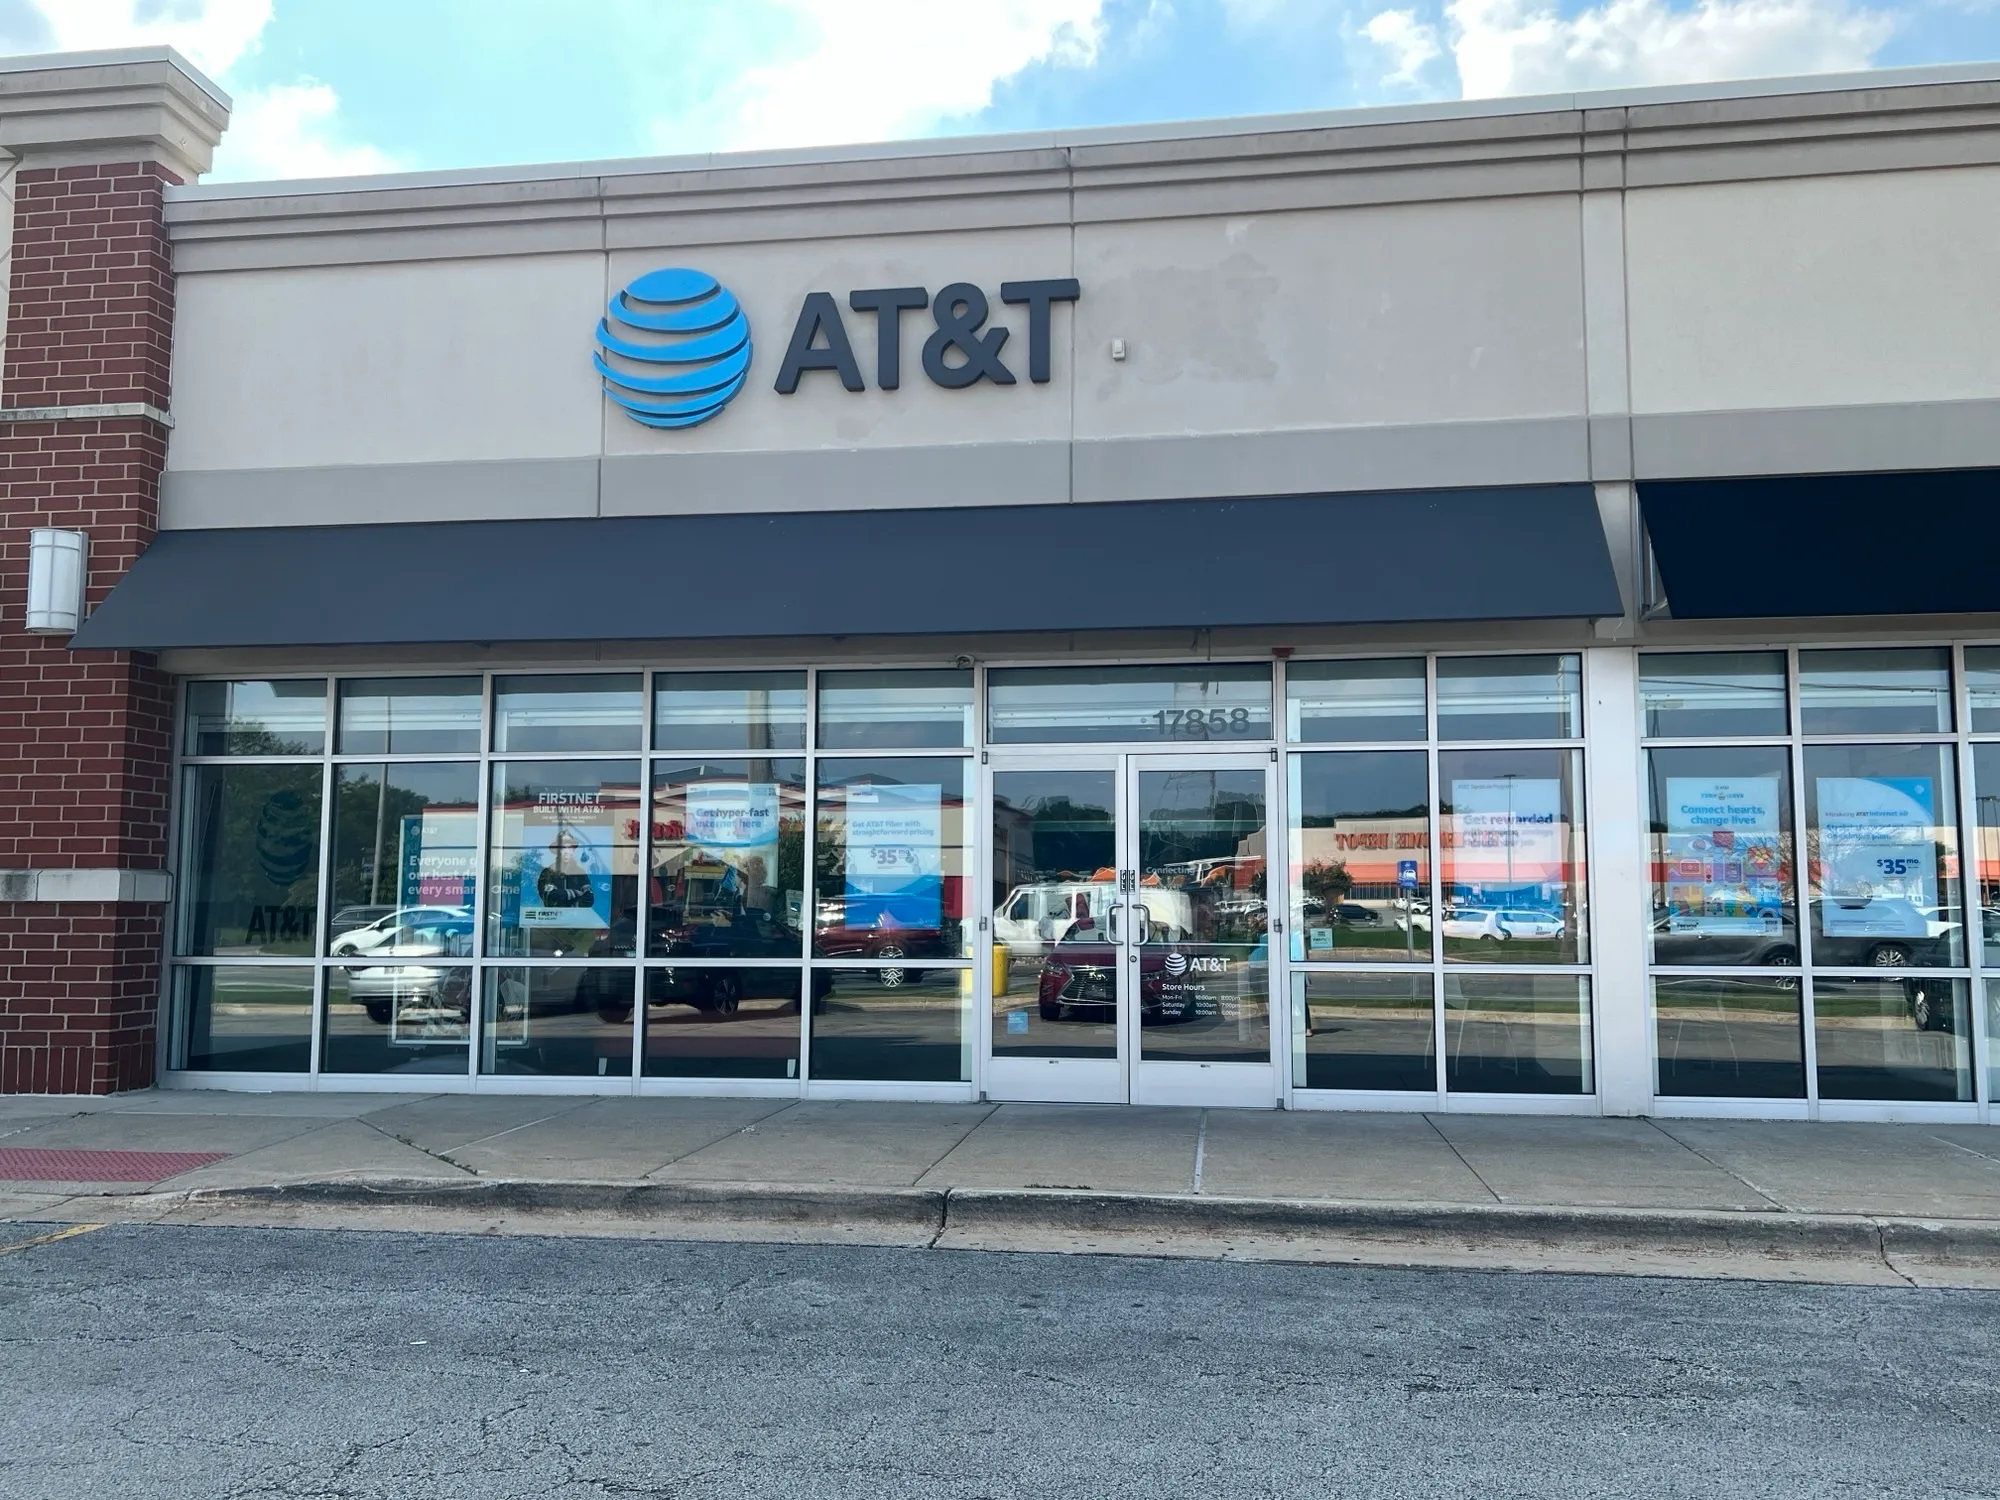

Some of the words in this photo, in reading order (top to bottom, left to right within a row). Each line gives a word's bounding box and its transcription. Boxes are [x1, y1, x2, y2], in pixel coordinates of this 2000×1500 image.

[774, 278, 1080, 394] AT&T
[1153, 708, 1250, 735] 17858
[538, 793, 603, 804] FIRSTNET
[696, 808, 716, 817] Get
[716, 808, 770, 819] hyper-fast
[1681, 805, 1724, 814] Connect
[1728, 805, 1765, 816] hearts,
[696, 819, 737, 829] internet
[739, 819, 761, 828] here
[1463, 814, 1488, 825] Get
[1490, 813, 1553, 825] rewarded
[1691, 815, 1728, 827] change
[1732, 815, 1756, 824] lives
[852, 827, 908, 837] straightforward
[910, 828, 934, 837] pricing
[409, 855, 466, 867] Everyone
[870, 848, 898, 865] $35
[1146, 866, 1195, 876] Connecting
[1876, 858, 1907, 875] $35
[408, 870, 431, 881] our
[432, 869, 460, 880] best
[408, 886, 444, 898] every
[245, 905, 317, 945] AT&T
[1190, 957, 1230, 971] AT&T
